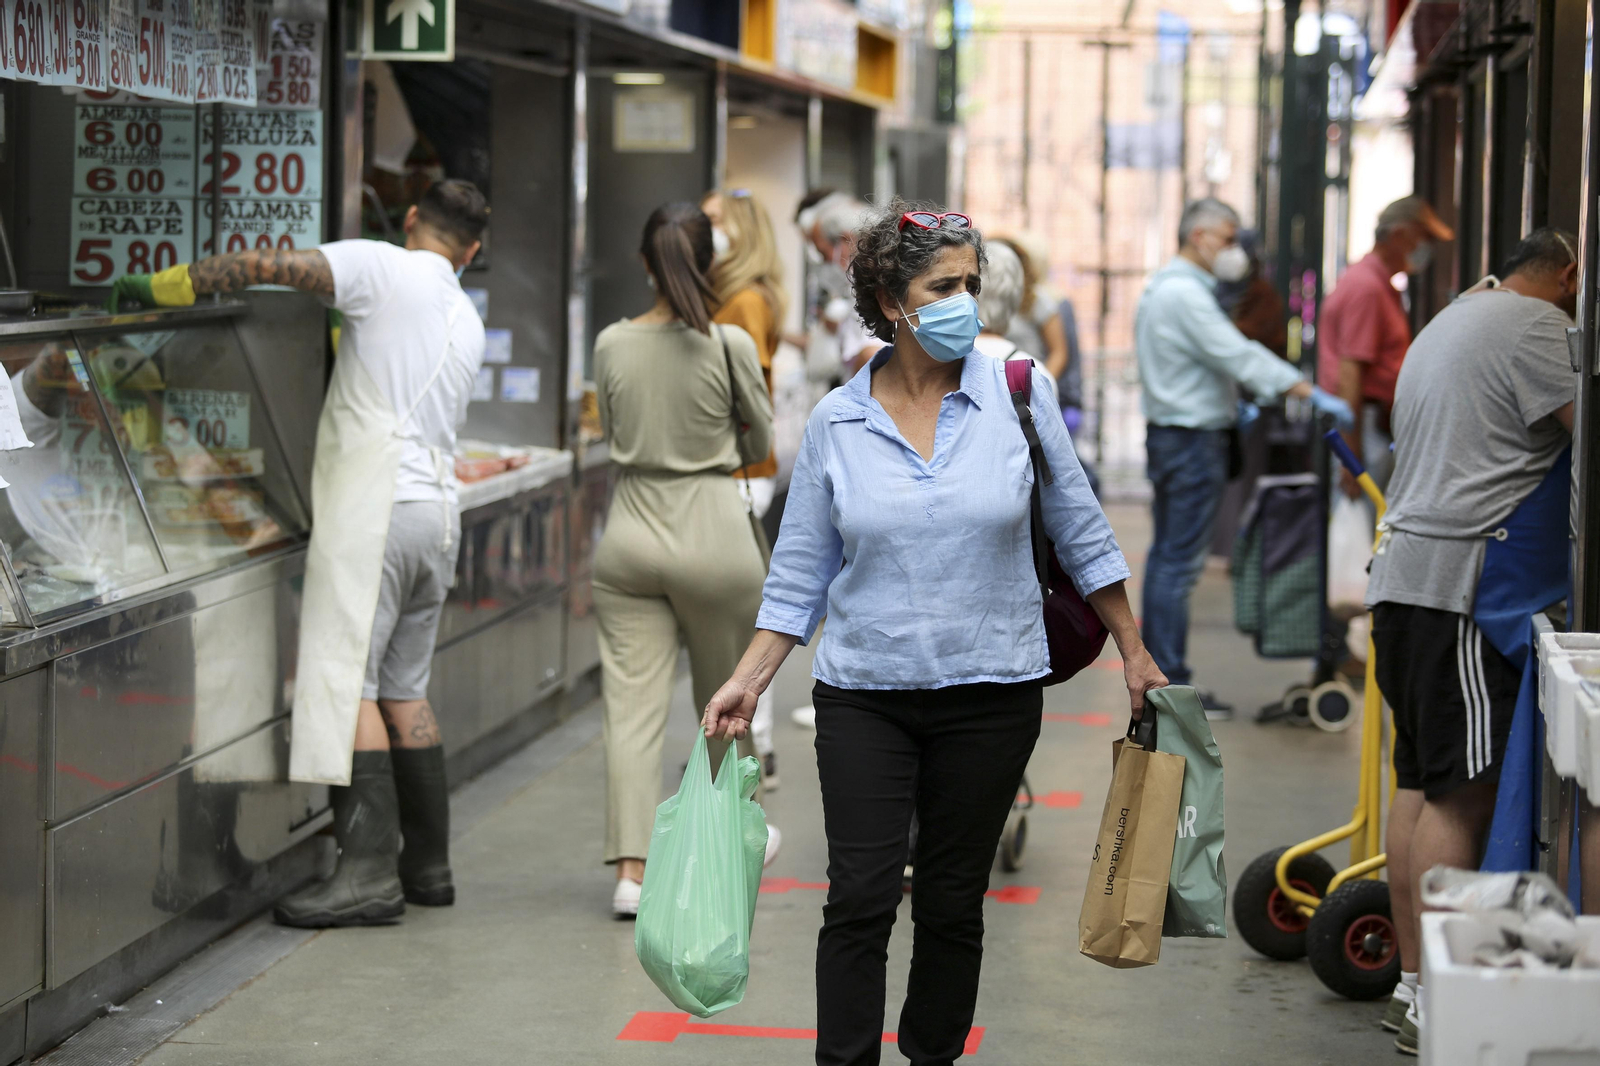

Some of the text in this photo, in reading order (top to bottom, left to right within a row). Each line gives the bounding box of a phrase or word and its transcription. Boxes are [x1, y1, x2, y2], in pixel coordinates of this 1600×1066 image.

[76, 30, 100, 43] GRANDE
[80, 107, 161, 121] ALMEJAS
[80, 200, 183, 216] CABEZA
[99, 217, 183, 235] RAPE
[1104, 808, 1130, 896] bershka.com
